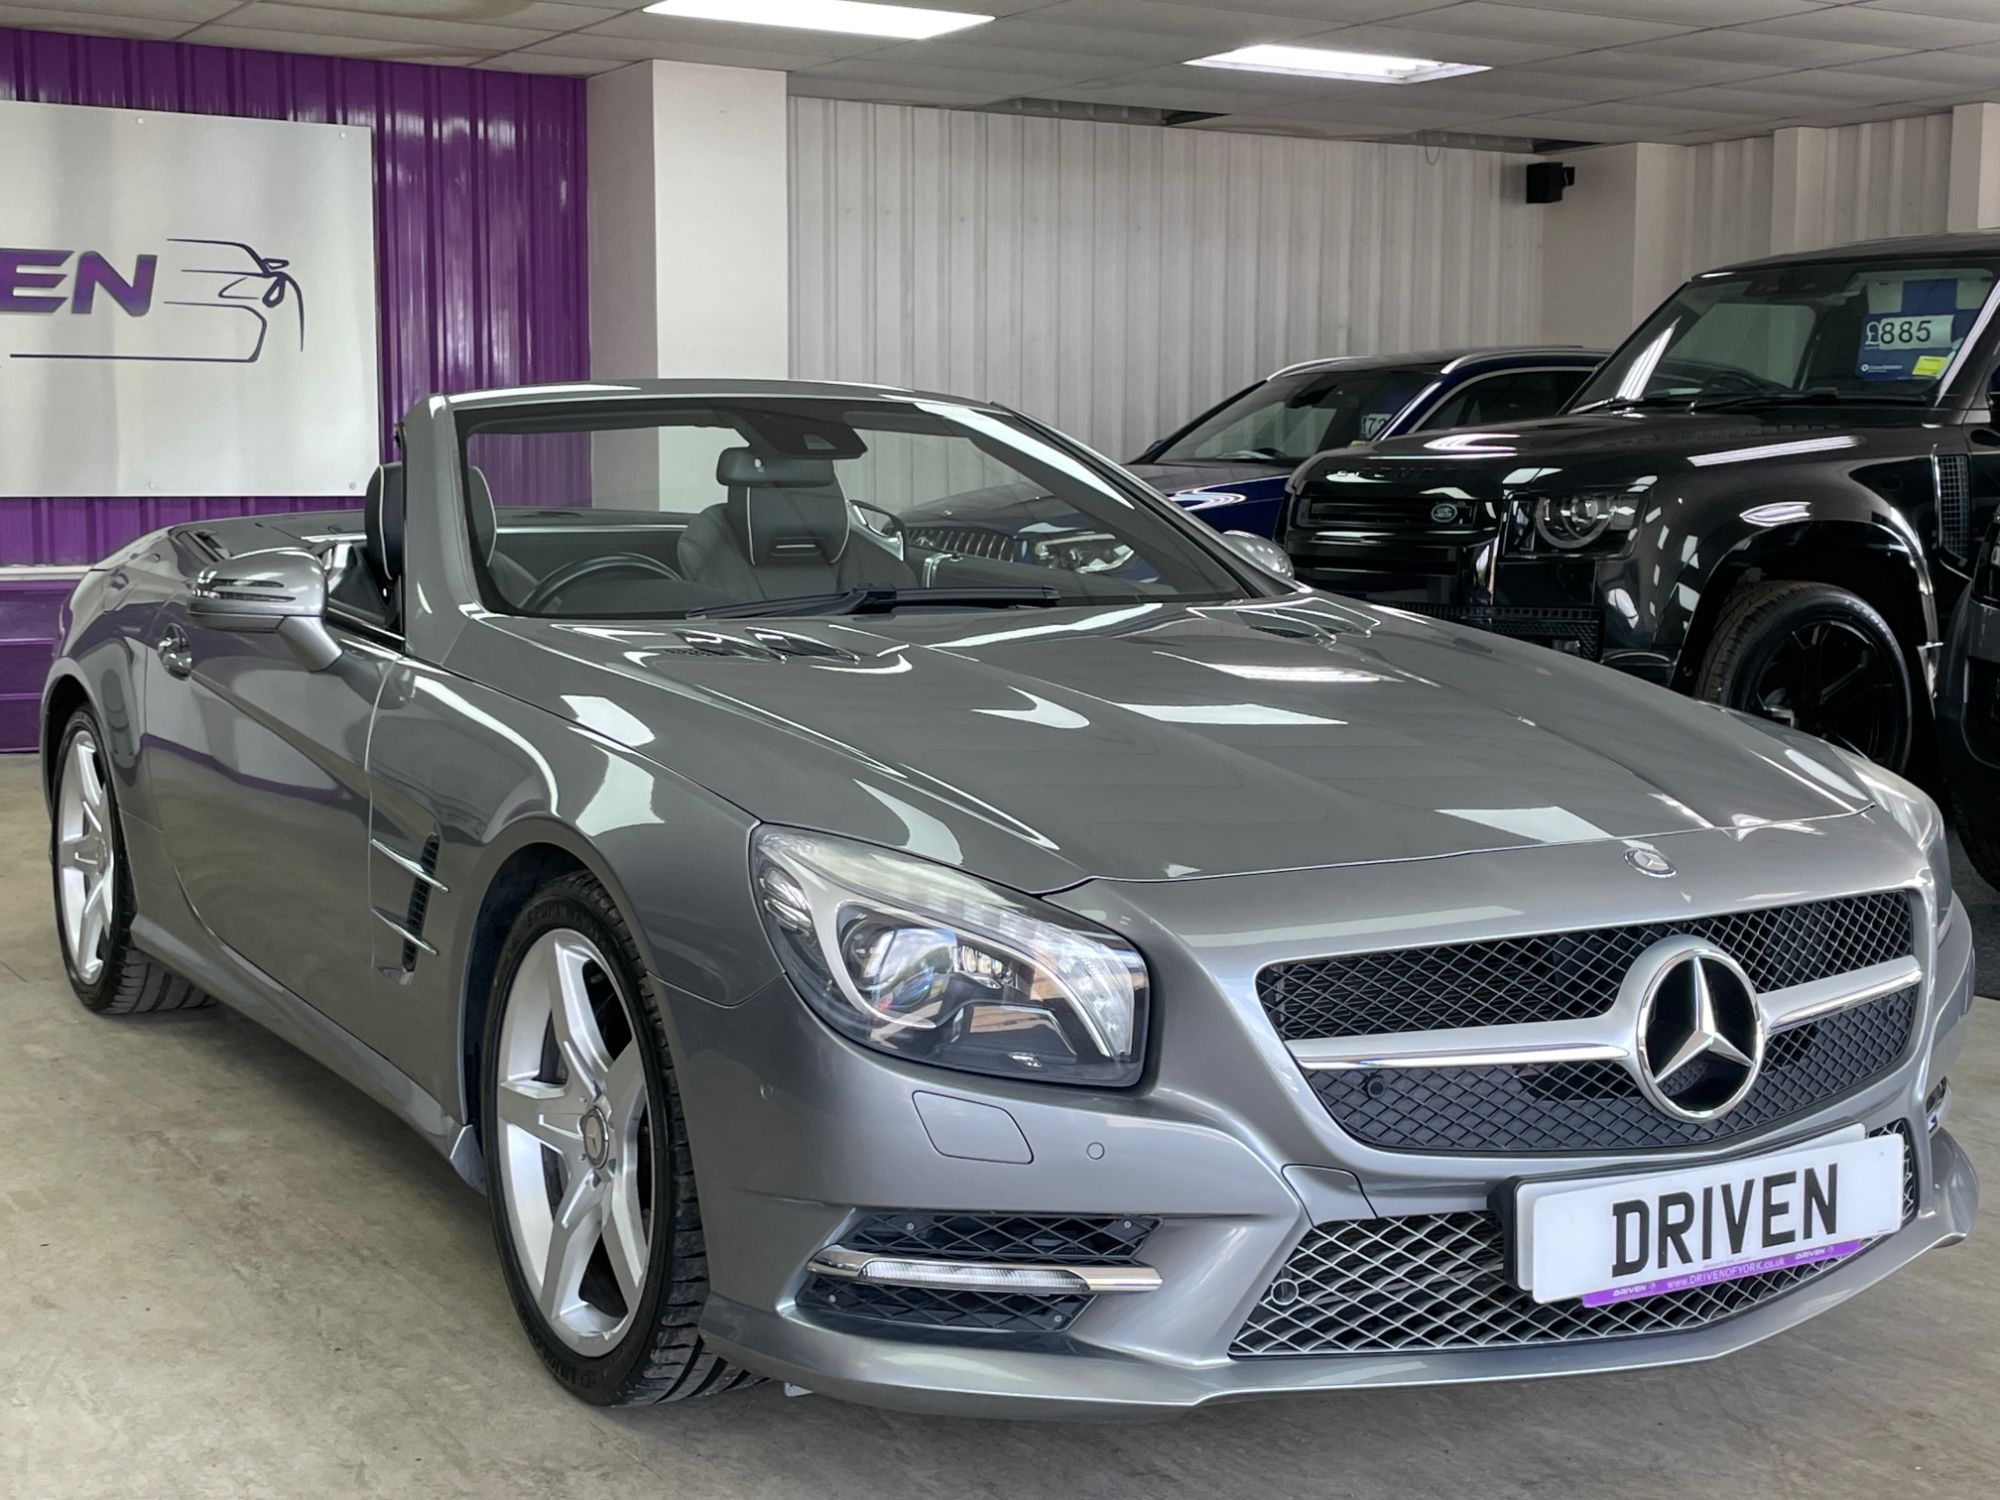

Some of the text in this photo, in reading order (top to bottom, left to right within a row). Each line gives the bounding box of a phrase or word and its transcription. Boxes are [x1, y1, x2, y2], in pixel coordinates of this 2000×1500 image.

[1864, 320, 1932, 344] £885
[1611, 1163, 1838, 1279] DRIVEN
[1613, 1283, 1647, 1297] DRIVEN
[1666, 1256, 1786, 1289] www.DRIVENOFYORK.co.uk
[1795, 1247, 1826, 1261] DRIVEN
